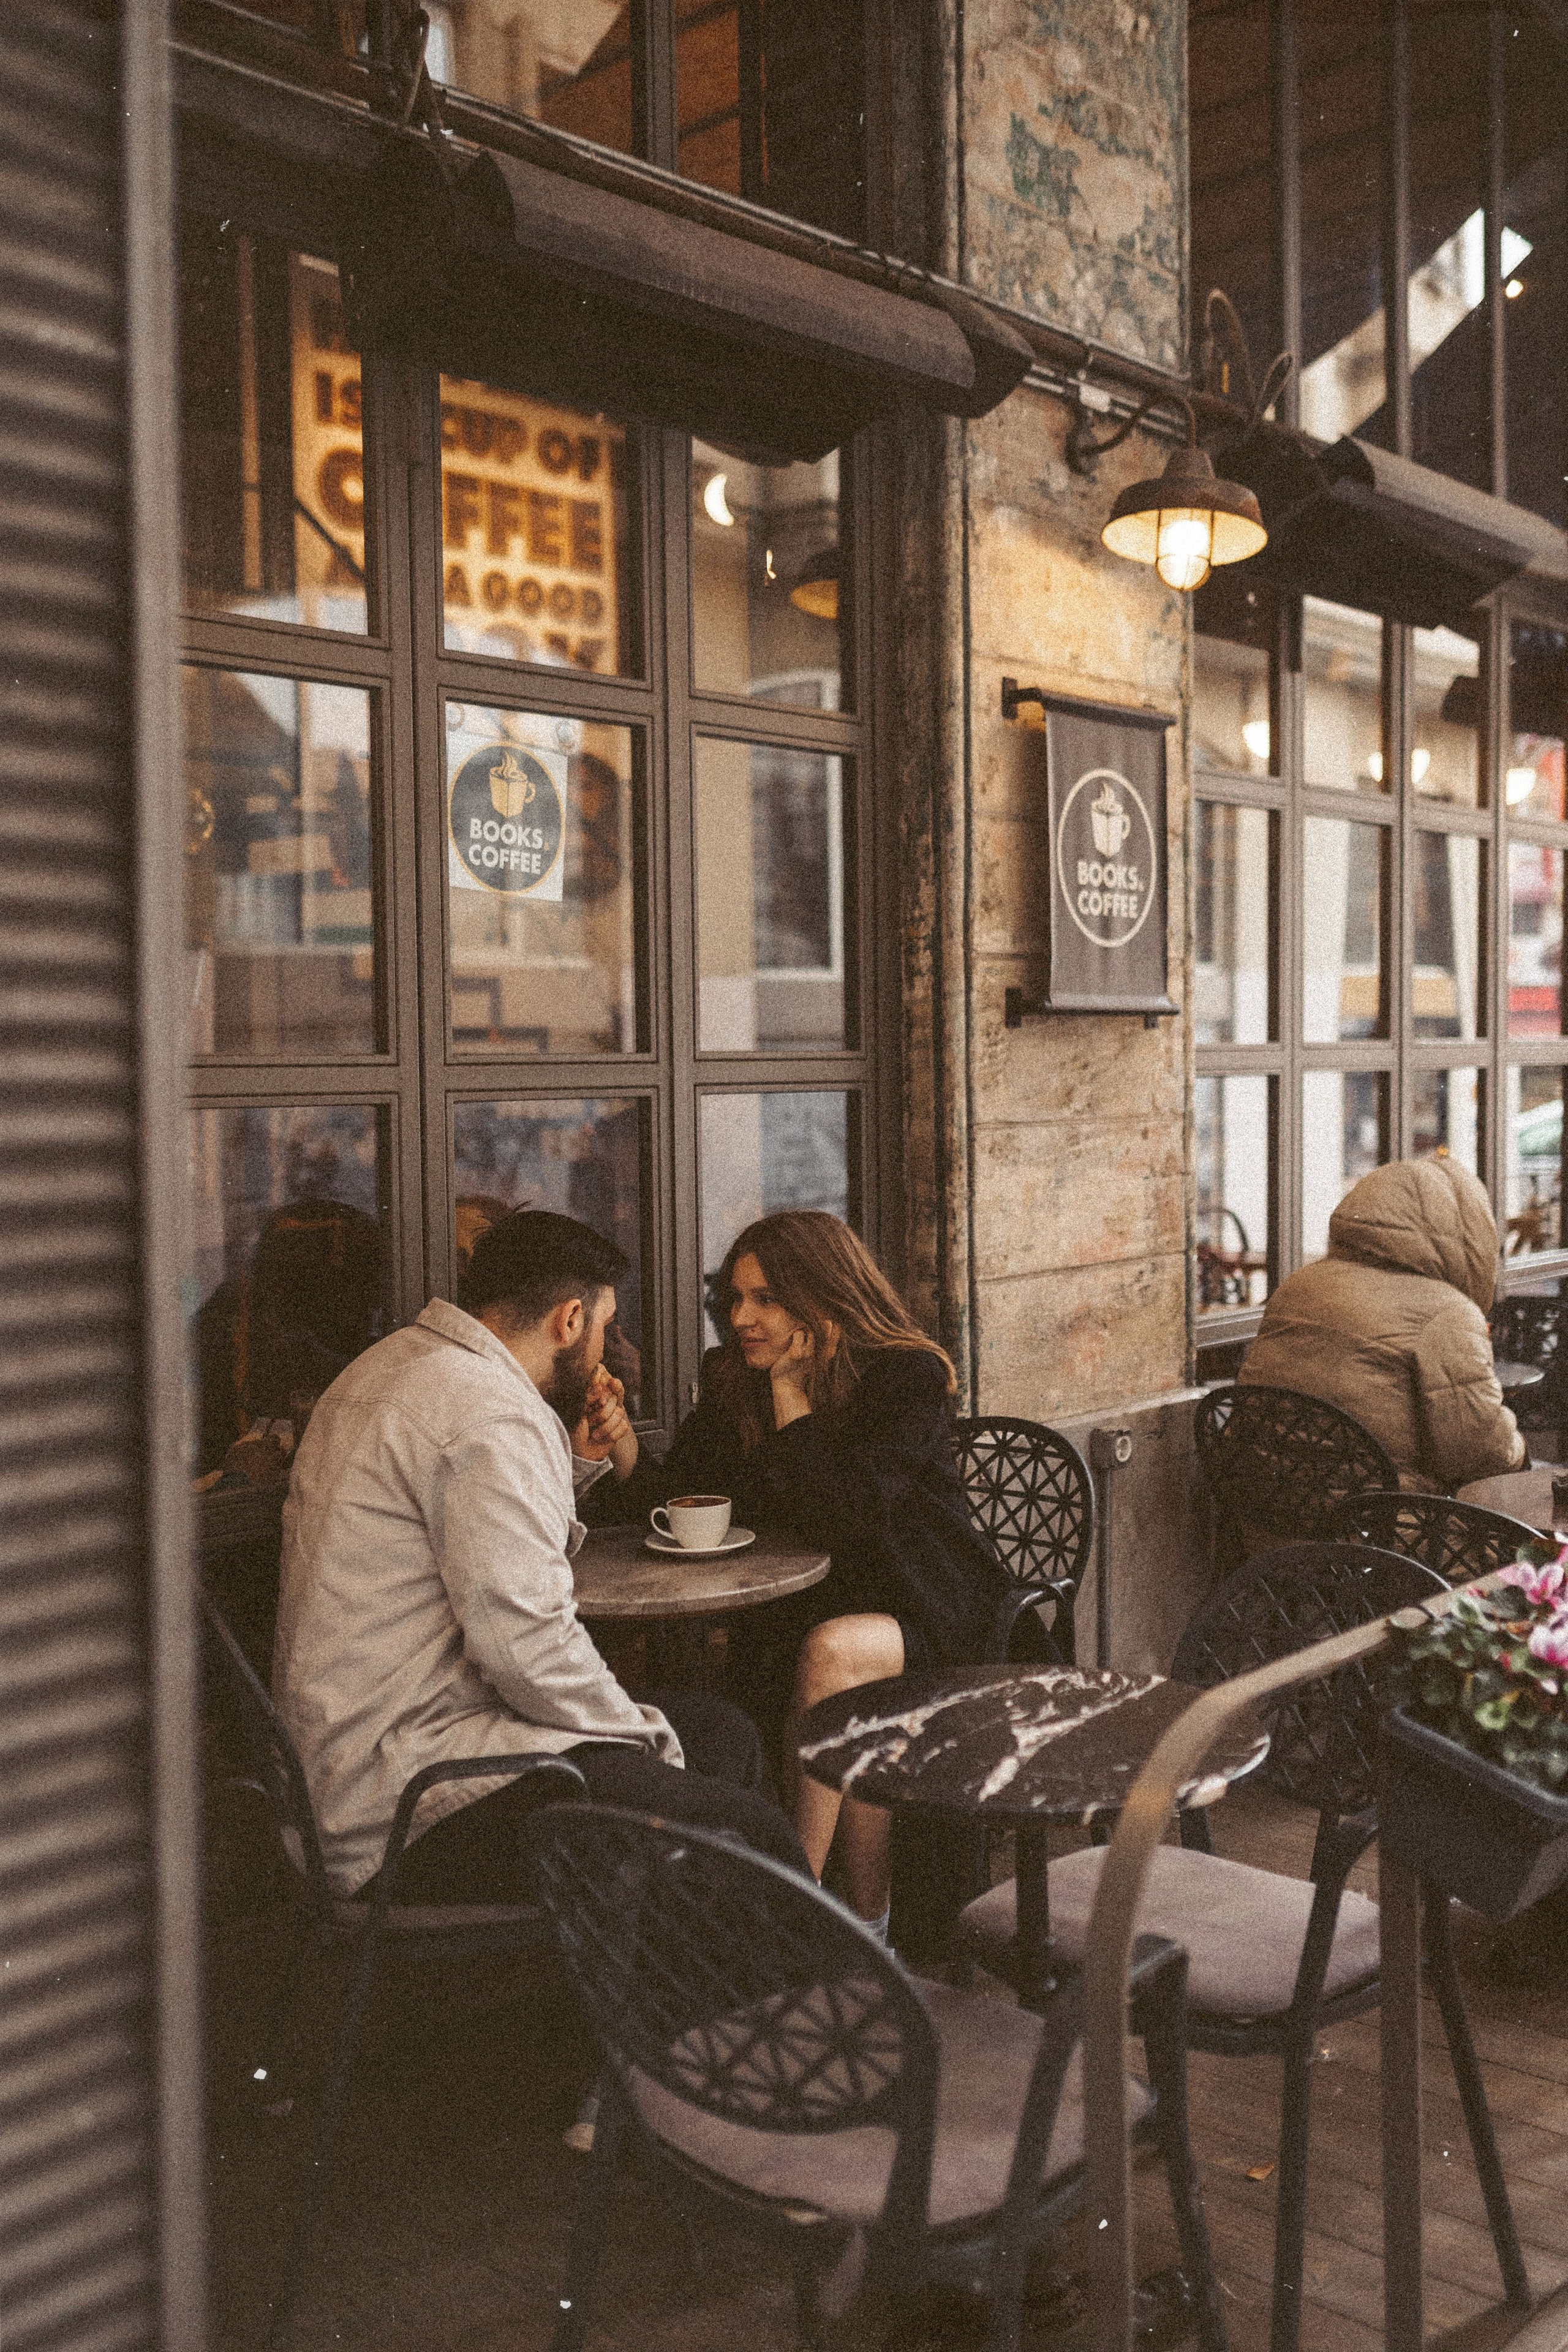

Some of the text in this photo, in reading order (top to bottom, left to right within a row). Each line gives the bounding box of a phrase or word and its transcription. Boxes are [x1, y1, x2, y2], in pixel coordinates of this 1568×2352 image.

[470, 818, 543, 850] BOOKS
[469, 844, 541, 875] COFFEE
[1077, 860, 1138, 890] BOOKS
[1077, 890, 1138, 919] COFFEE
